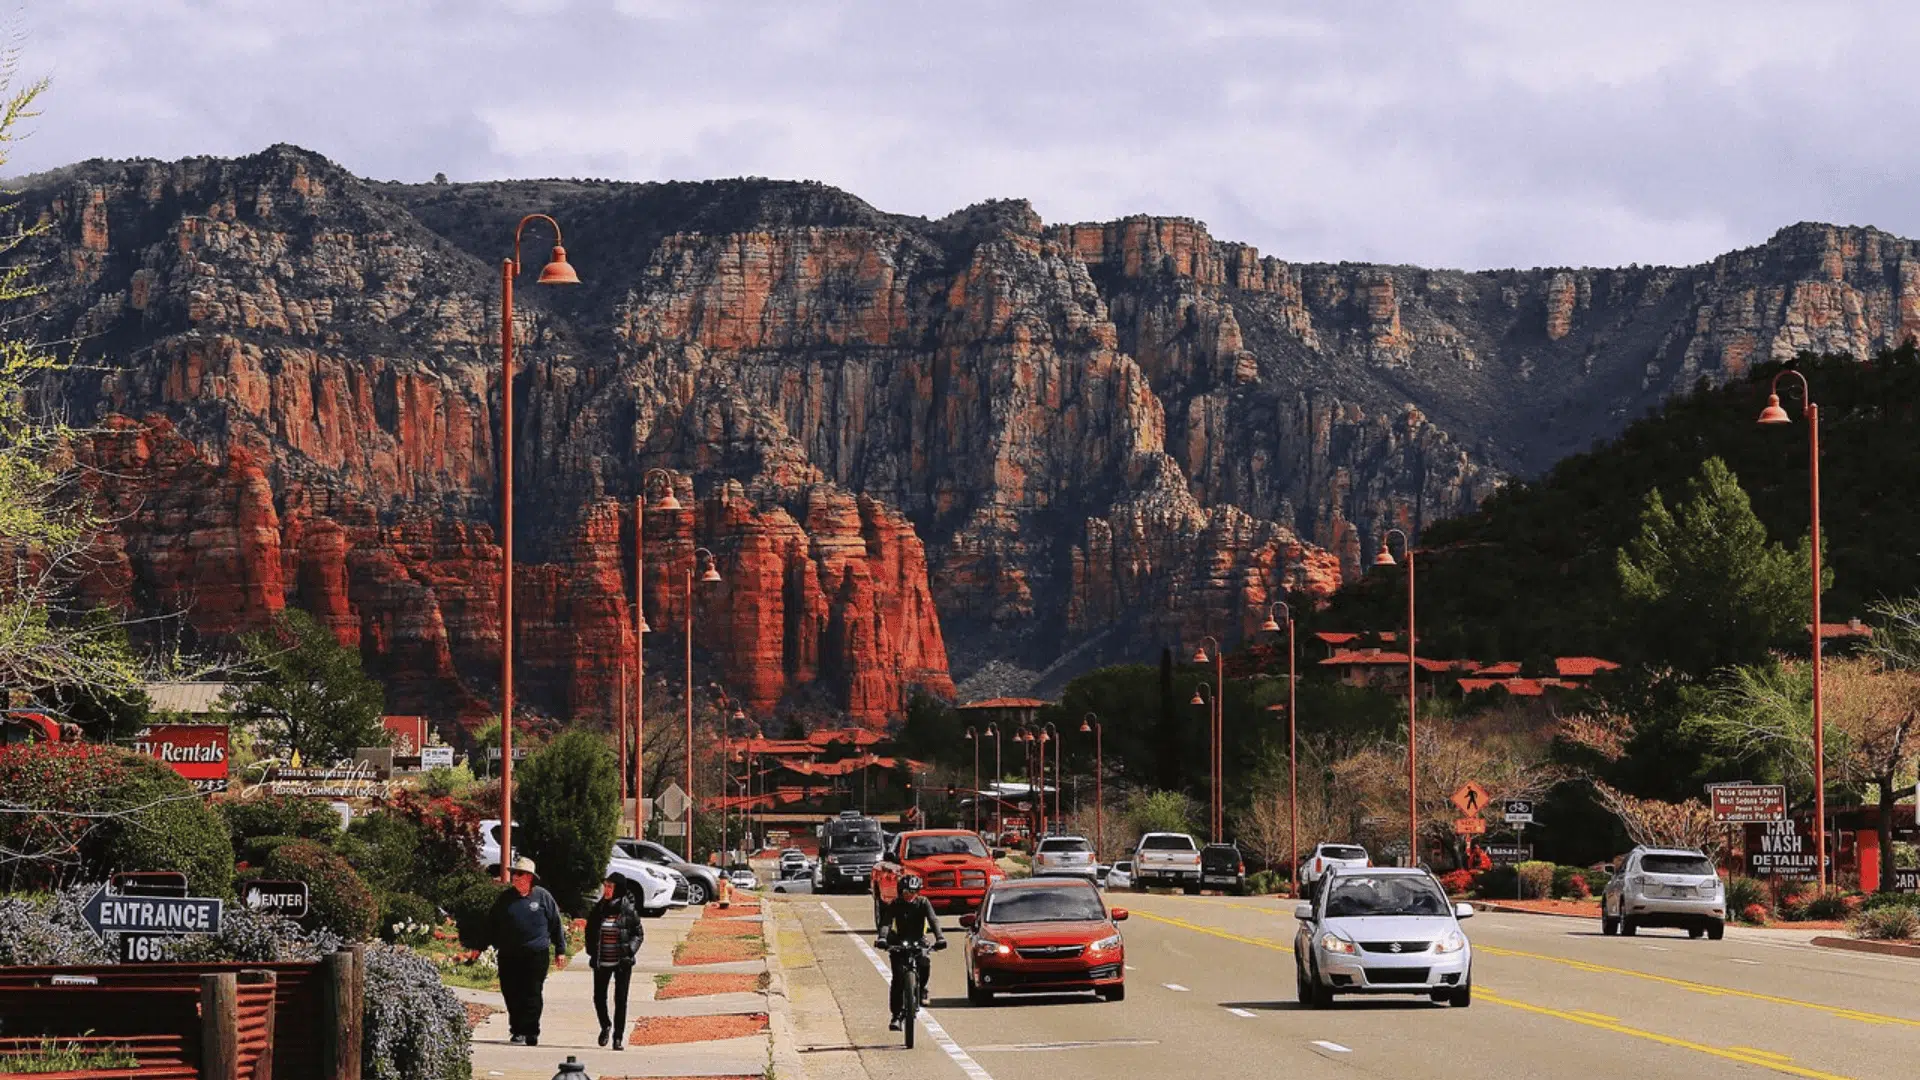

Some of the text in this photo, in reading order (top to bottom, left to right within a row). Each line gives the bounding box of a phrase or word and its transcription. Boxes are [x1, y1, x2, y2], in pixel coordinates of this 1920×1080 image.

[161, 741, 225, 762] Rentals
[1766, 819, 1795, 835] CAR
[1761, 835, 1802, 853] WASH
[262, 893, 303, 907] ENTER
[100, 901, 210, 929] ENTRANCE
